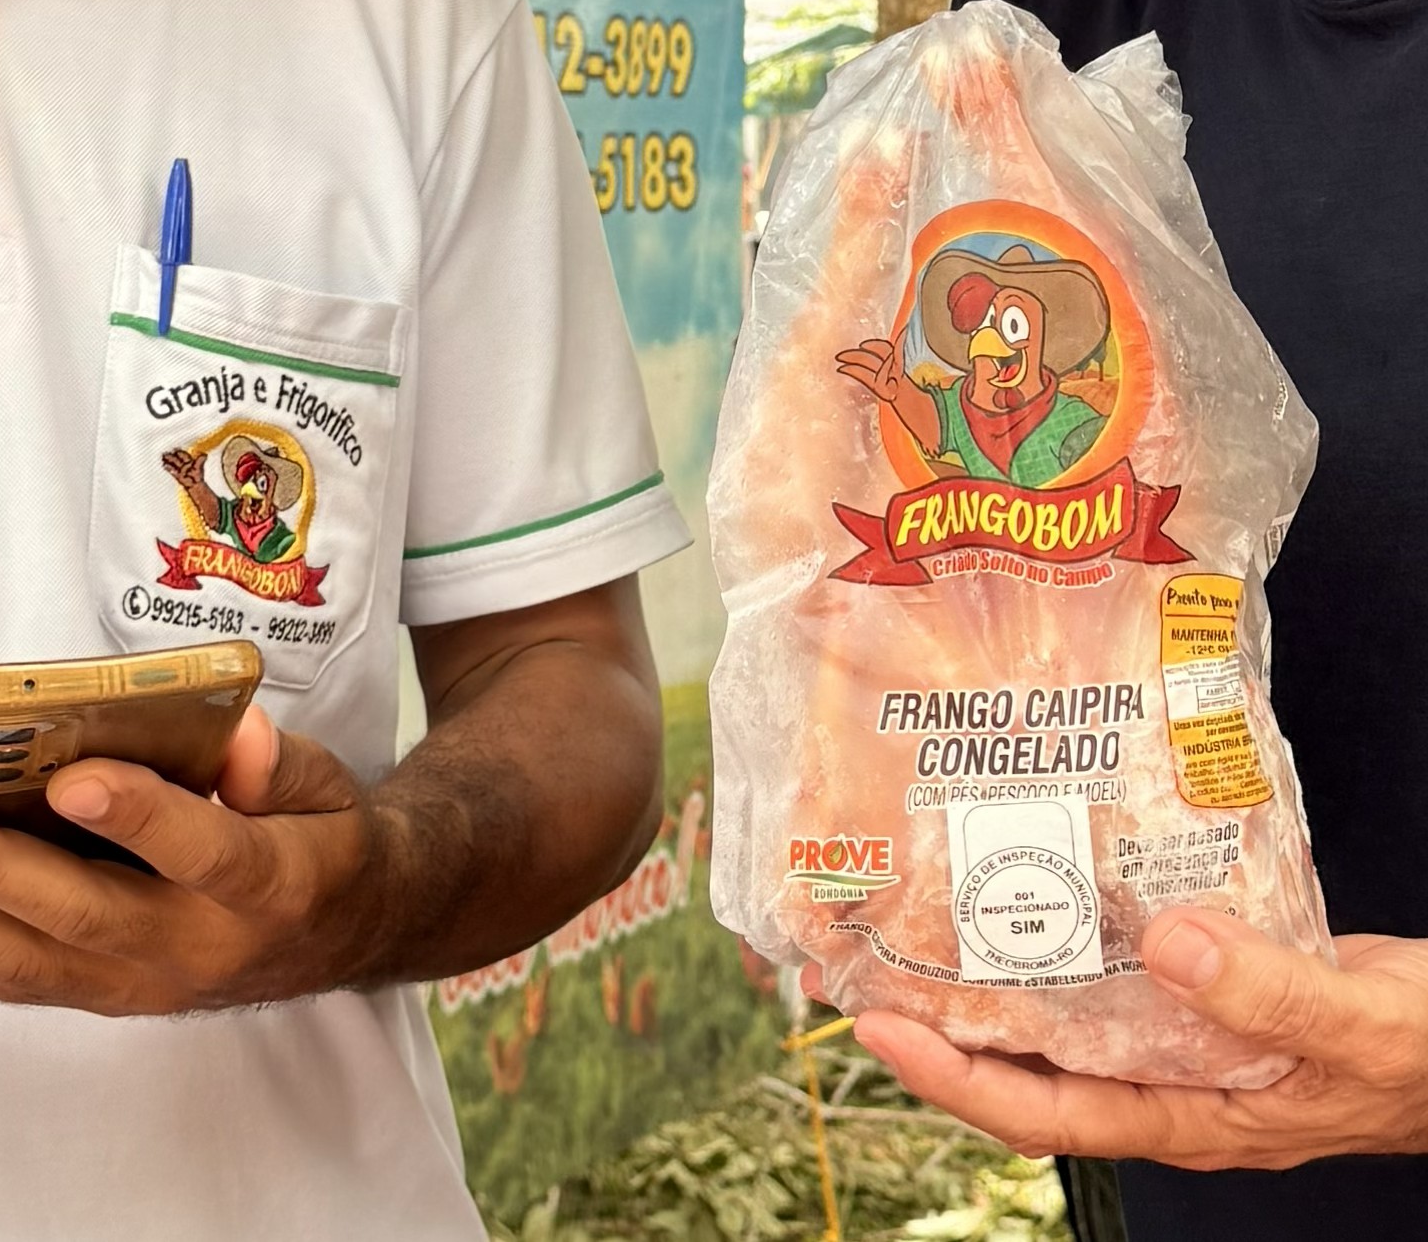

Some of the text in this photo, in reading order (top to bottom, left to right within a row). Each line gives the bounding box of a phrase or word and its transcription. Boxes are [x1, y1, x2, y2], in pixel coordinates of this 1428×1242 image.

[145, 366, 245, 420] Granja
[254, 377, 267, 403] e
[895, 483, 1124, 552] FRANGOBOM
[932, 549, 1113, 587] Criado Solto no Campo
[151, 596, 244, 635] 99215-5183
[1171, 628, 1229, 642] MANTENHA
[879, 683, 1145, 731] FRANGO CAIPIRA
[918, 731, 1120, 777] CONGELADO
[1183, 738, 1241, 756] INDÚSTRIA
[790, 839, 890, 871] PROVE
[1122, 861, 1143, 879] em
[1223, 844, 1239, 863] do
[959, 851, 1093, 927] SERVIÇO DE INSPEÇÃO MUNICIPAL
[1015, 891, 1035, 901] 001
[981, 901, 1070, 915] INSPECIONADO
[1010, 920, 1045, 935] SIM
[898, 957, 960, 983] PRODUZIDO
[1104, 962, 1120, 977] NA
[1122, 959, 1148, 972] NOR
[984, 946, 1074, 970] THEOBROMA-RO
